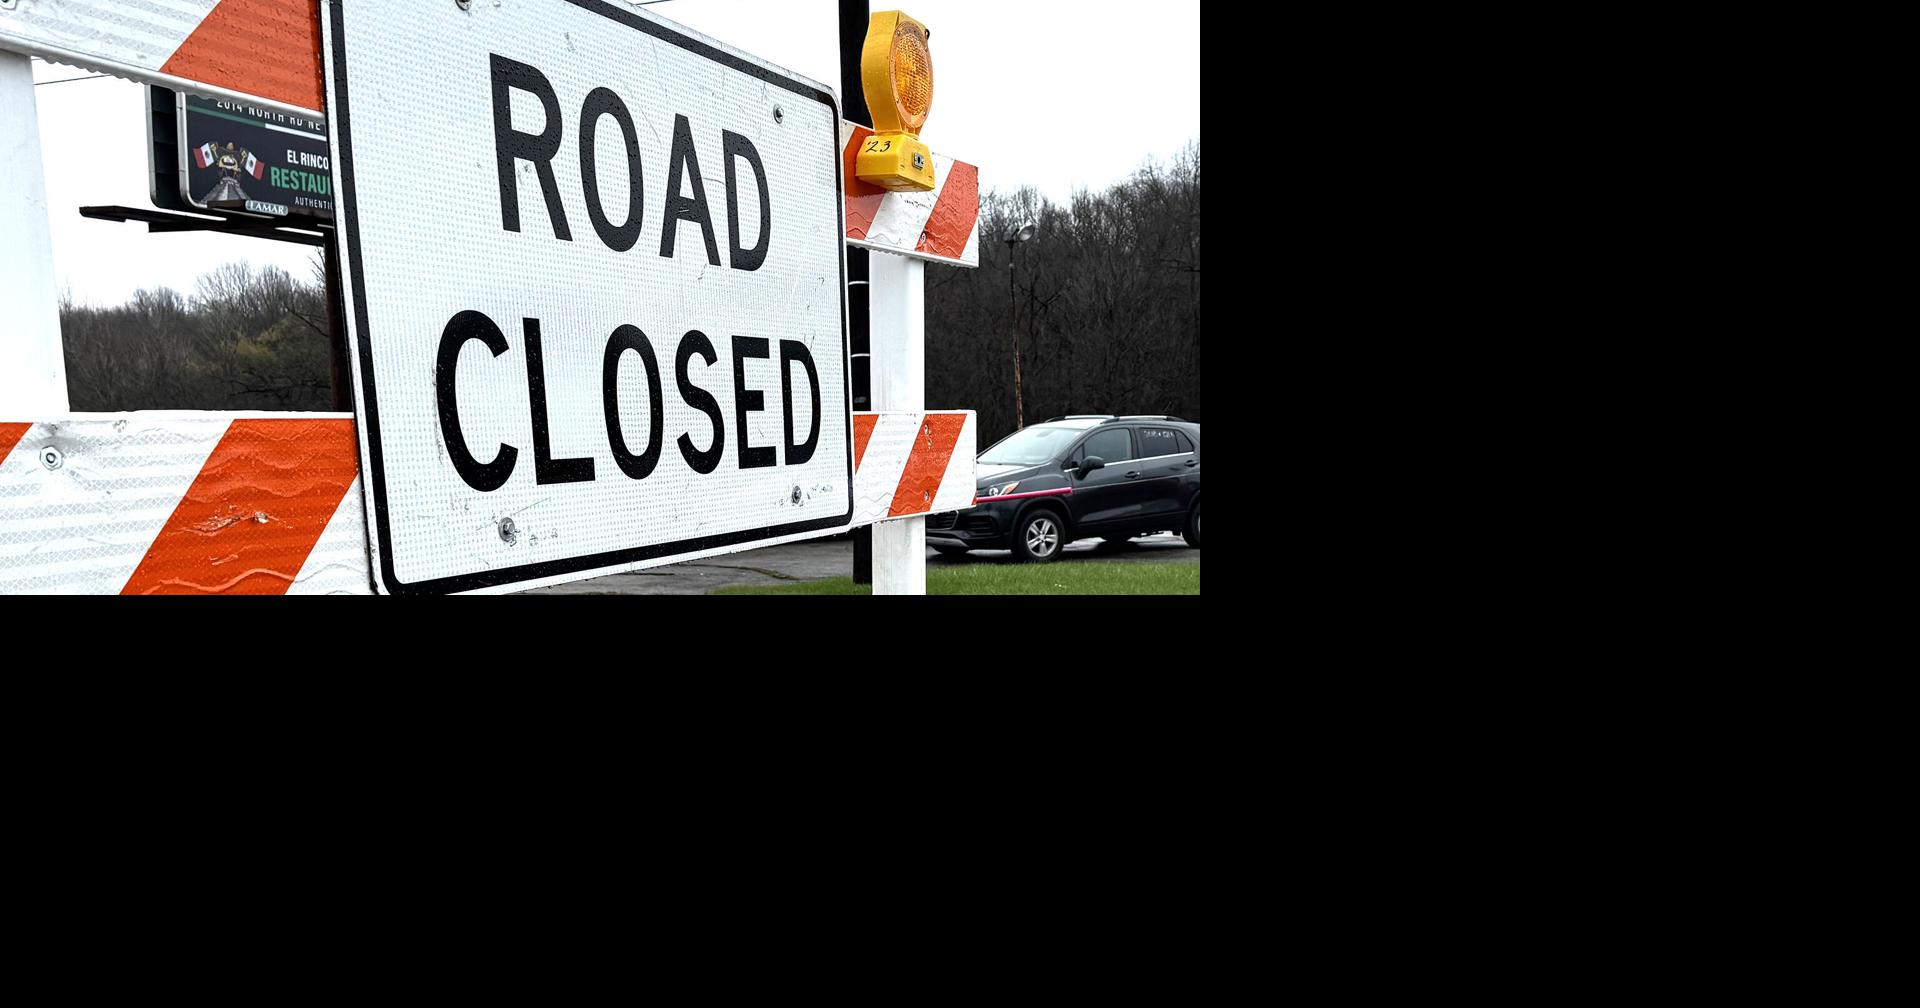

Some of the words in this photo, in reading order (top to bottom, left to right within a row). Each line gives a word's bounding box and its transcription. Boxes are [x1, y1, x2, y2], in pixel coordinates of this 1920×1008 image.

[287, 149, 299, 164] EL
[490, 53, 771, 272] ROAD
[250, 202, 285, 214] LAMAR
[436, 310, 821, 492] CLOSED
